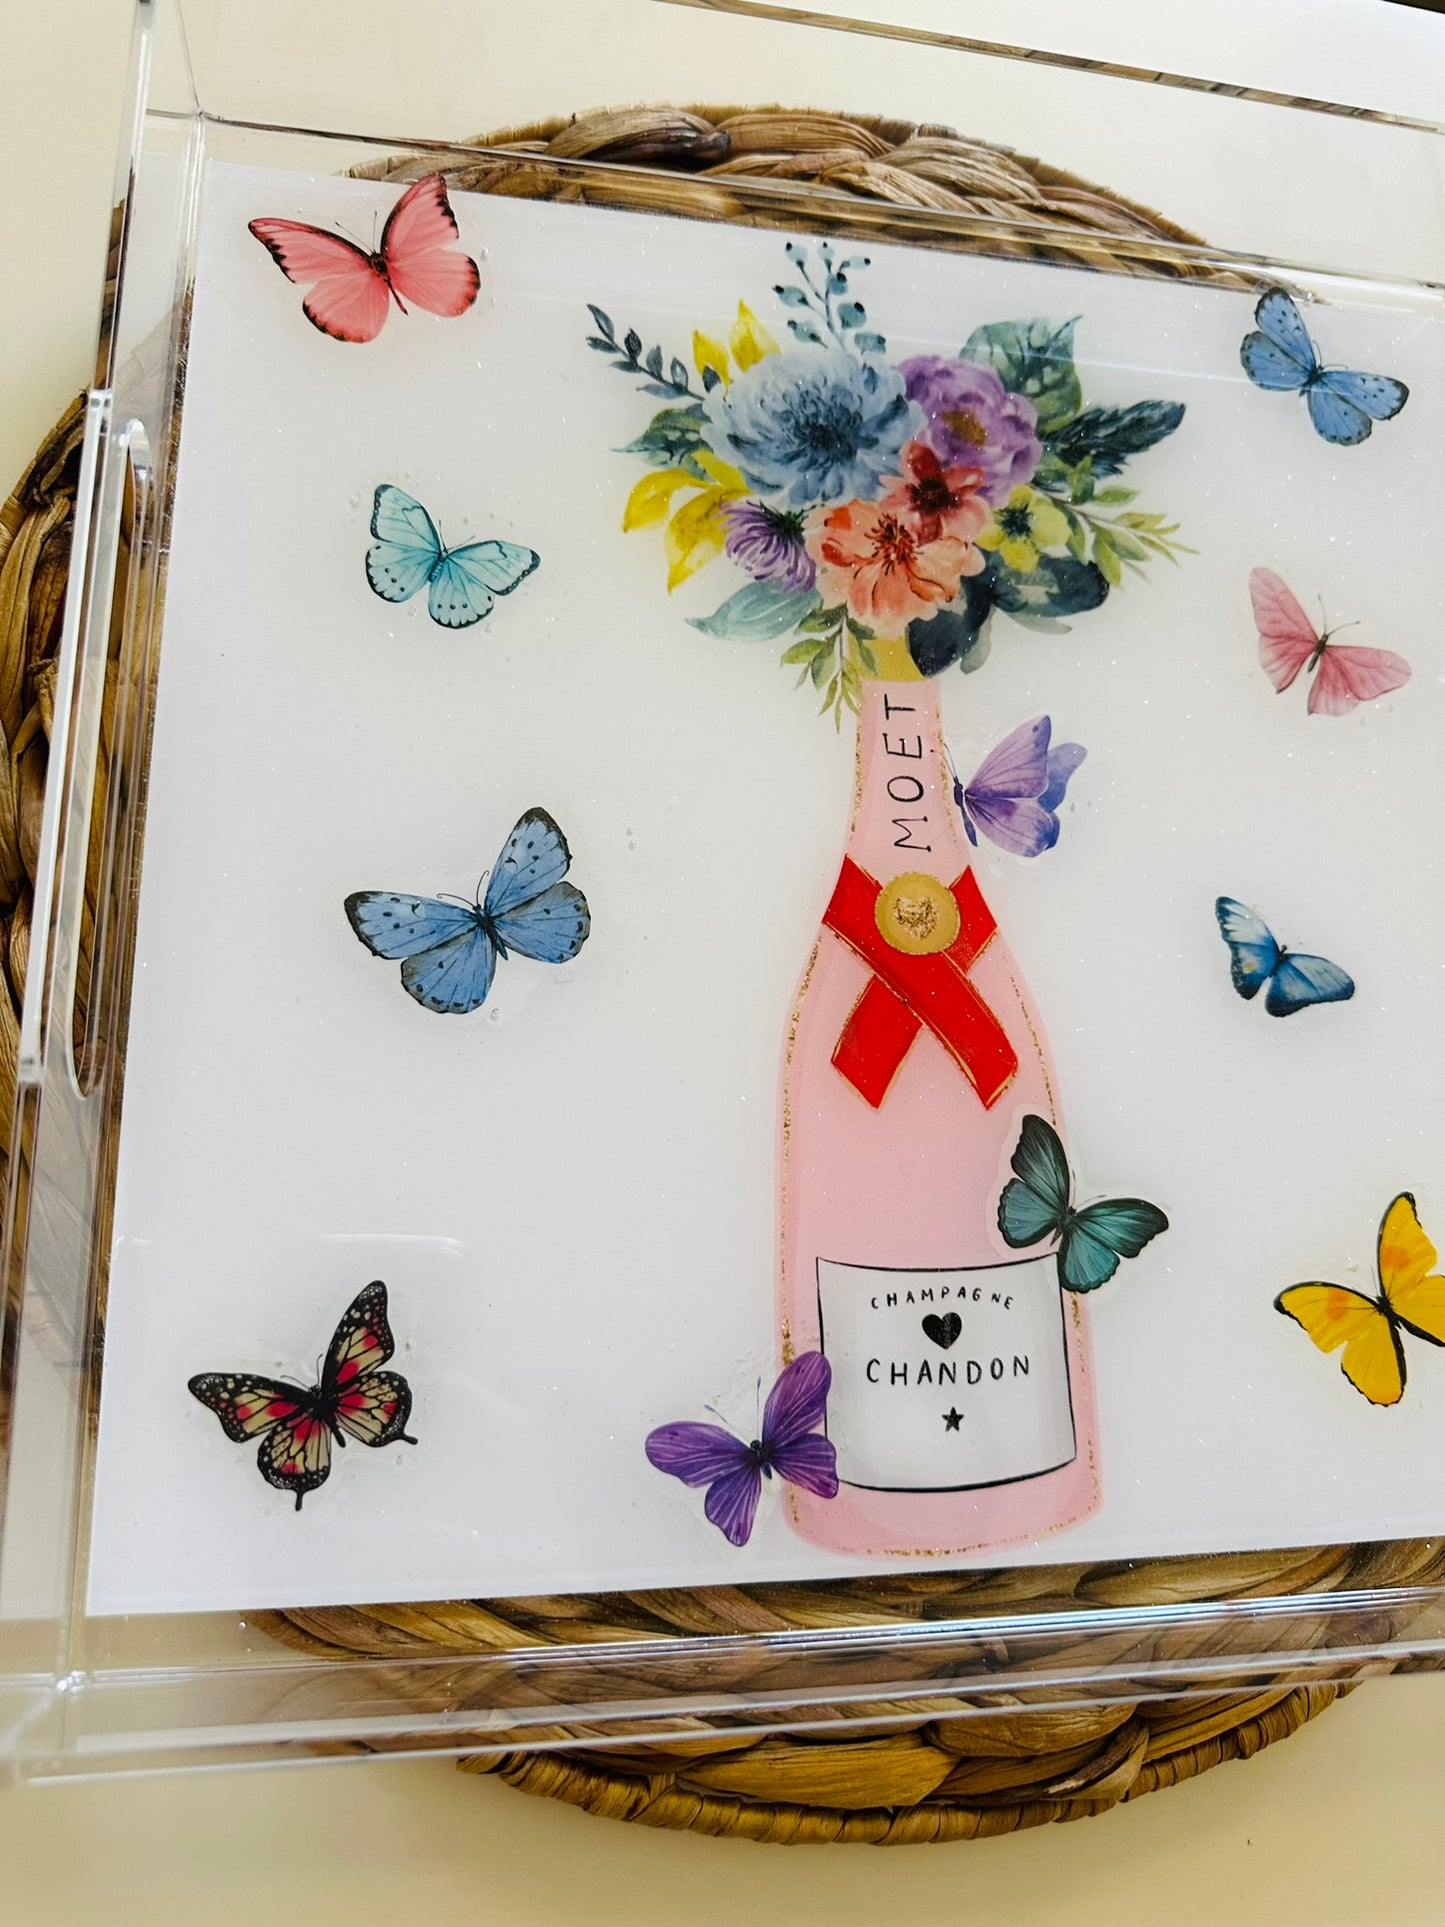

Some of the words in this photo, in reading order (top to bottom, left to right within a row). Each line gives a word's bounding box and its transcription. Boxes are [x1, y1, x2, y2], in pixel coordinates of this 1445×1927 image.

[881, 693, 932, 853] MOET
[870, 1285, 1014, 1310] CHAMPAGNE
[866, 1354, 1030, 1386] CHANDON
